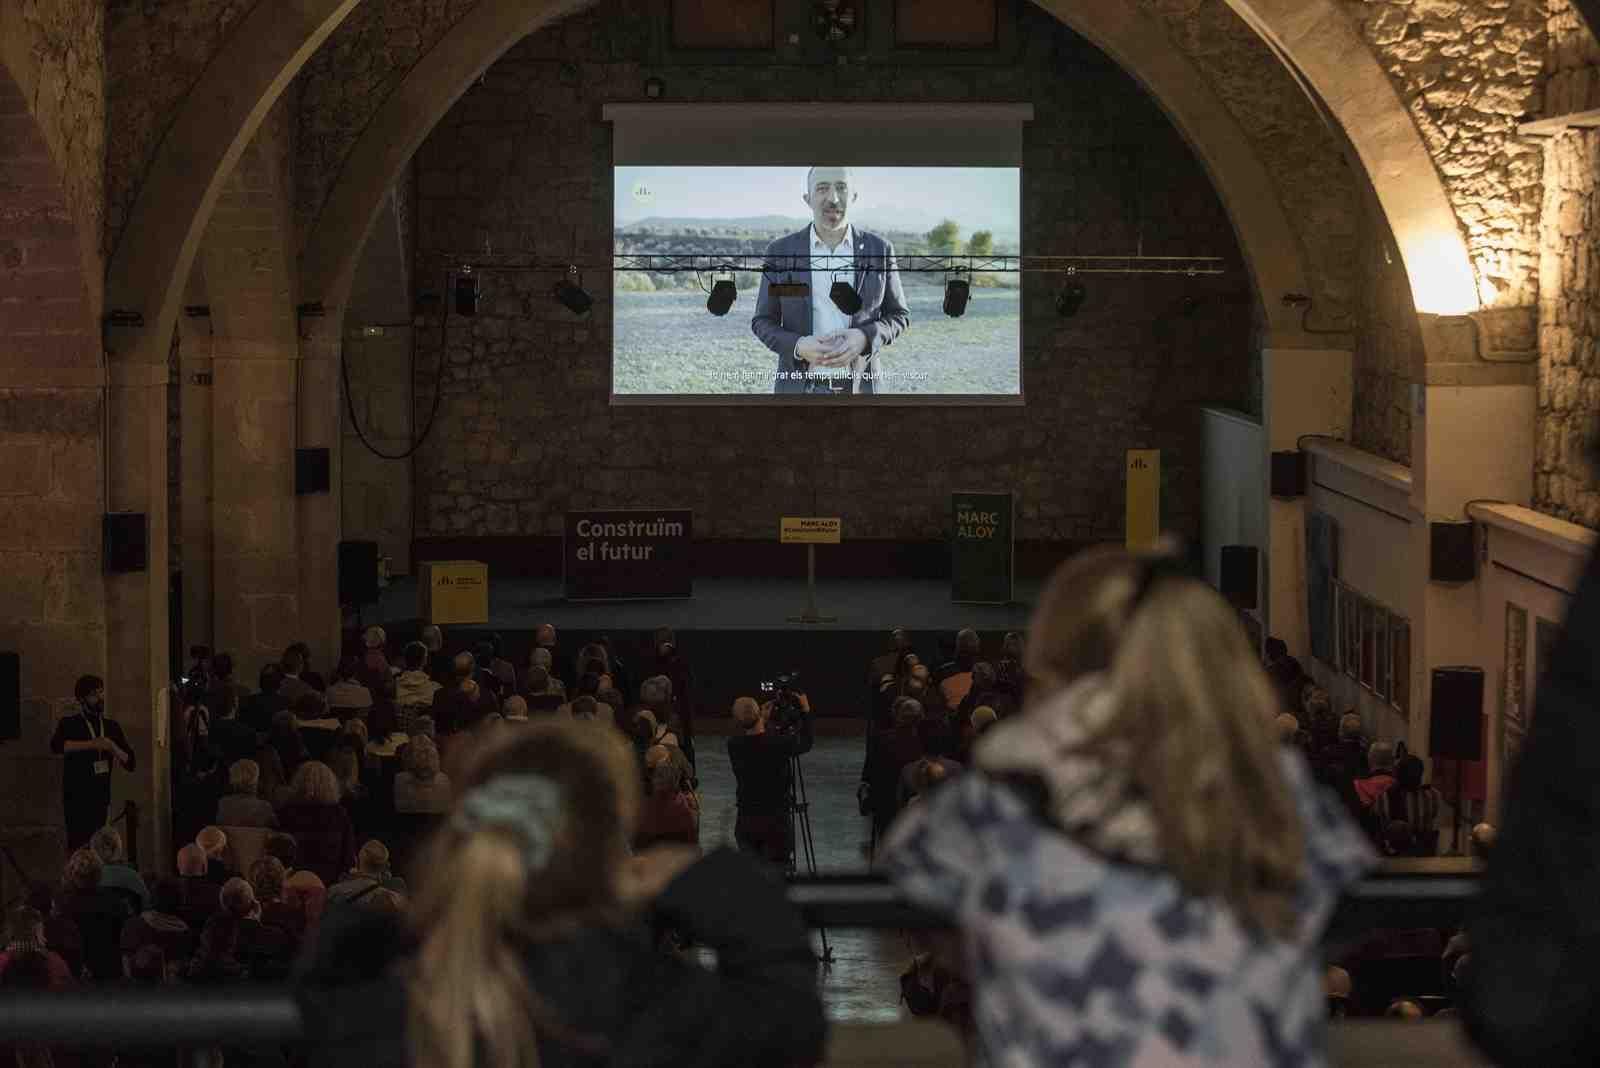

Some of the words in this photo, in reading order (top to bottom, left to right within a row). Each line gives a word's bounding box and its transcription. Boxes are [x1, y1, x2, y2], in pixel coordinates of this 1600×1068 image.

[791, 370, 803, 380] els
[957, 511, 1000, 525] MARC
[576, 517, 684, 537] Construïm
[957, 526, 996, 539] ALOY
[576, 541, 594, 561] el
[599, 541, 653, 561] futur
